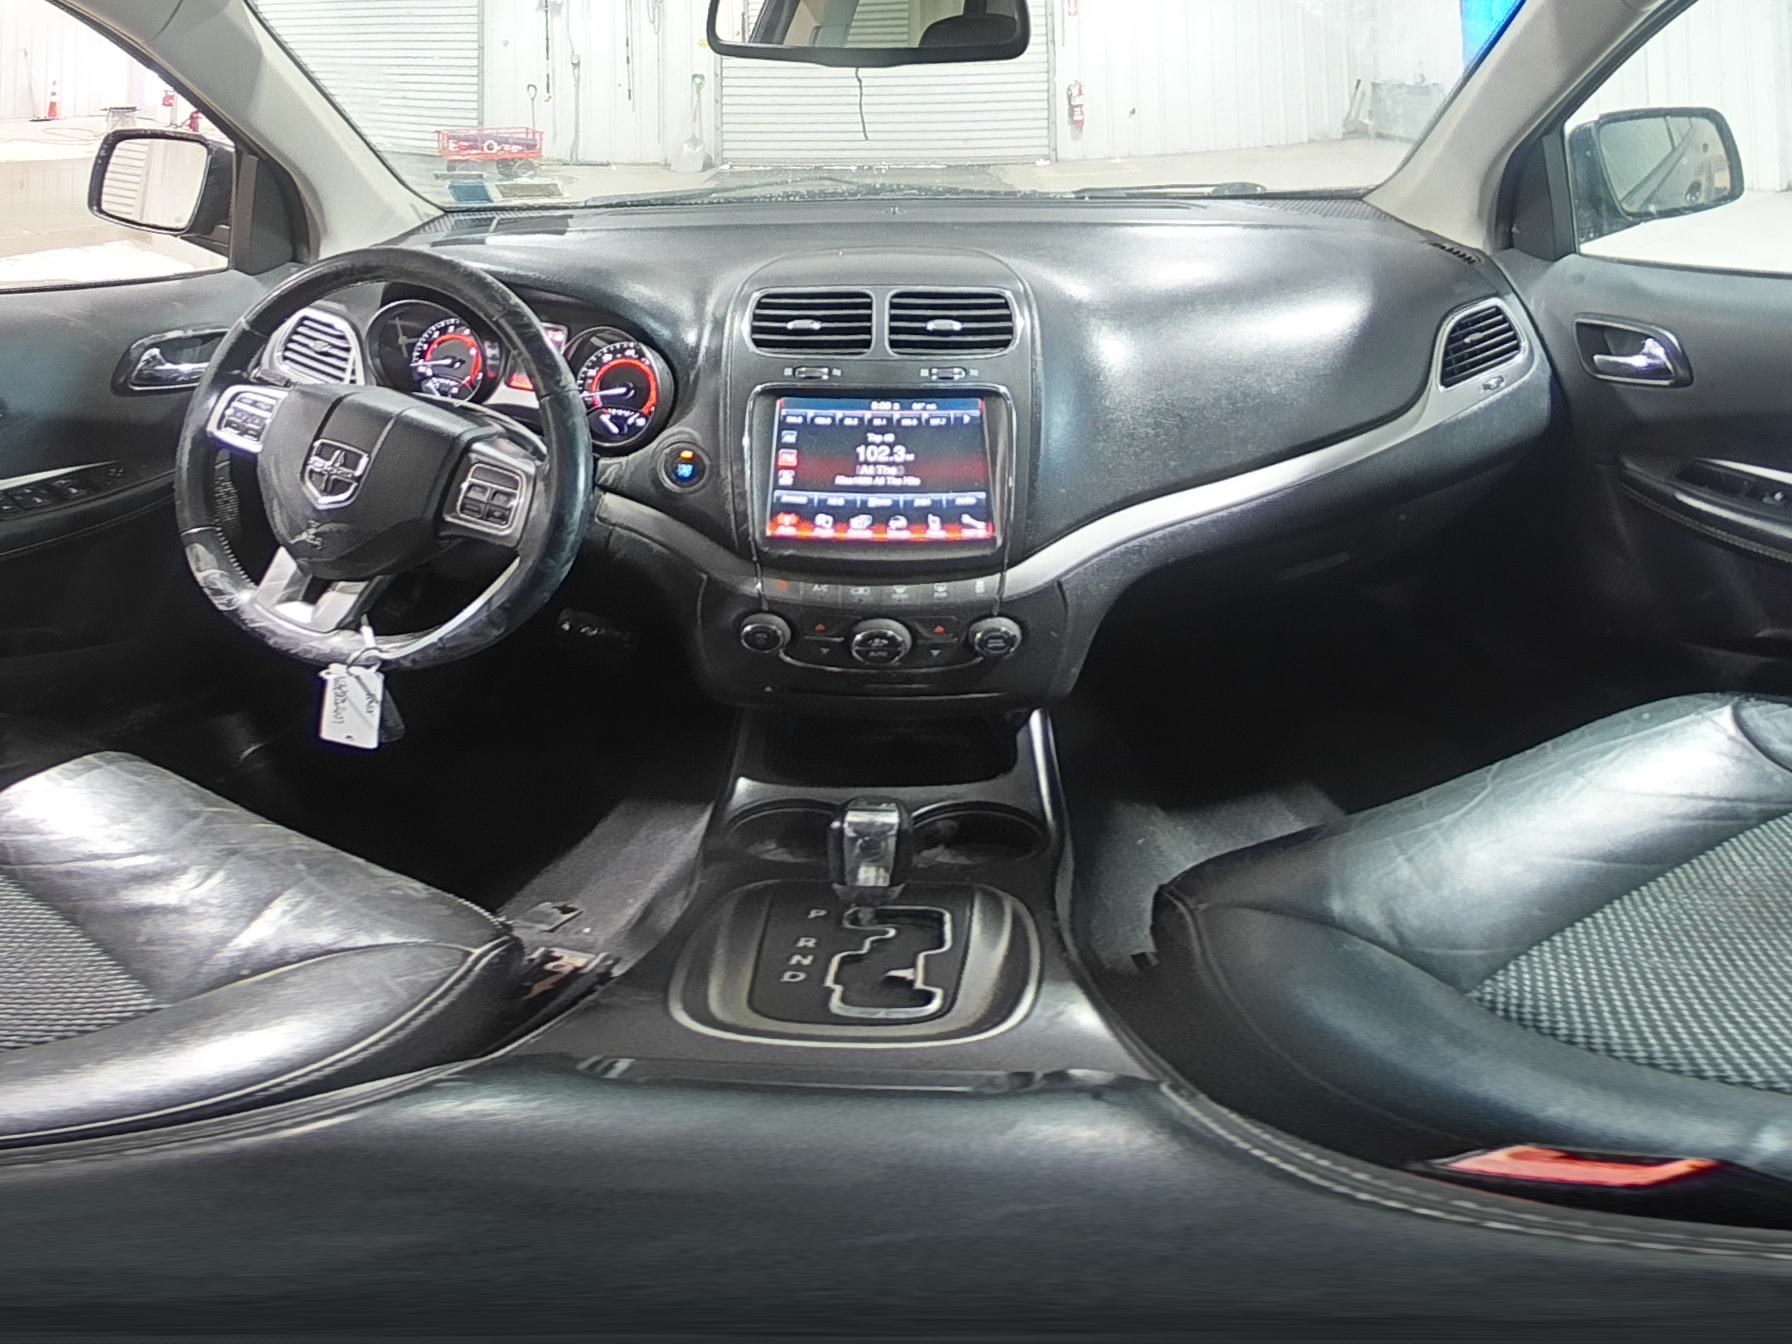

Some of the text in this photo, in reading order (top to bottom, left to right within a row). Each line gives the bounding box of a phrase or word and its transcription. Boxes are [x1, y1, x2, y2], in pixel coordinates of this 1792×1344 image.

[855, 444, 907, 463] 102.3
[807, 909, 828, 919] P
[795, 937, 818, 948] R
[789, 954, 813, 966] N
[780, 971, 807, 983] D
